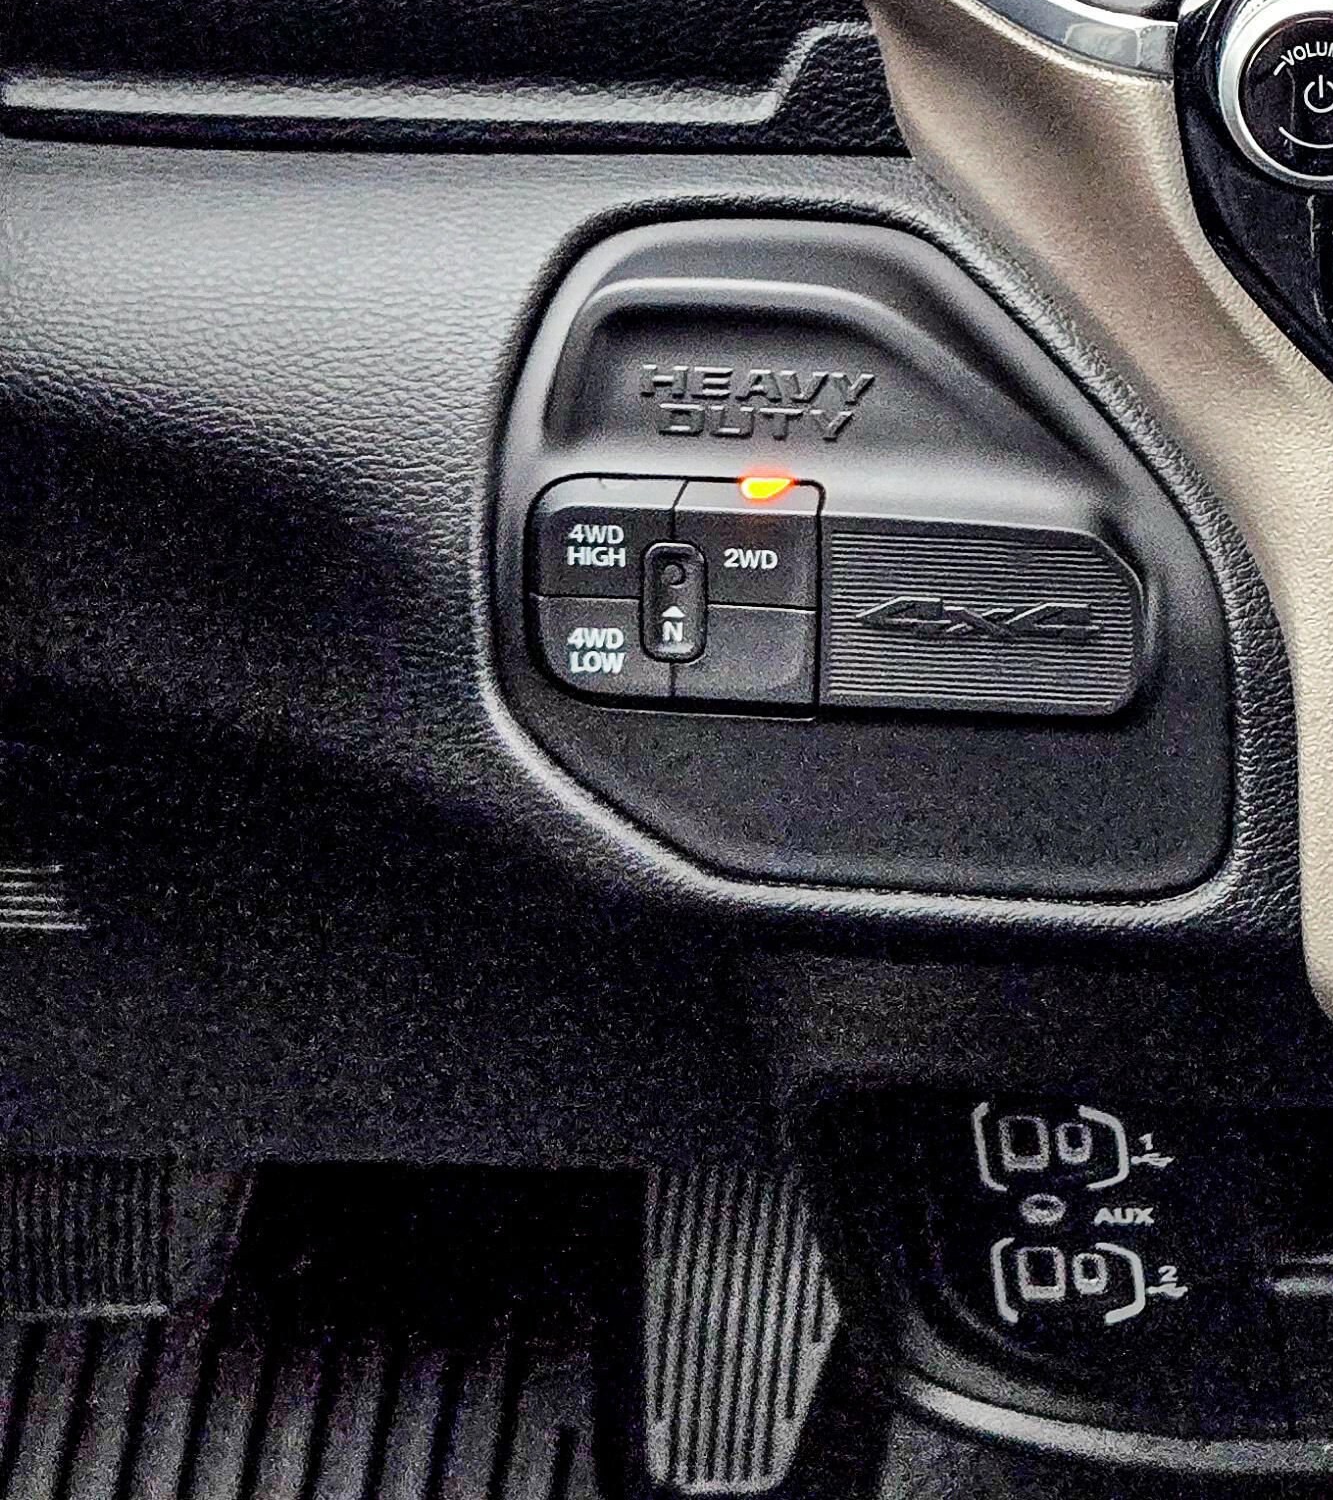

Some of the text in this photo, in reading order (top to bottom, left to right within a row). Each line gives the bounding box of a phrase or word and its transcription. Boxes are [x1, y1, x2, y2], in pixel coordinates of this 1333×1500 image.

[640, 364, 876, 405] HEAVY
[657, 403, 856, 442] DUTY
[567, 524, 625, 545] 4WD
[567, 546, 627, 568] HIGH
[723, 548, 779, 570] 2WD
[567, 627, 625, 650] 4WD
[662, 621, 684, 643] N
[570, 651, 626, 674] LOW
[1094, 1206, 1155, 1226] AUX
[1157, 1265, 1178, 1283] 2
